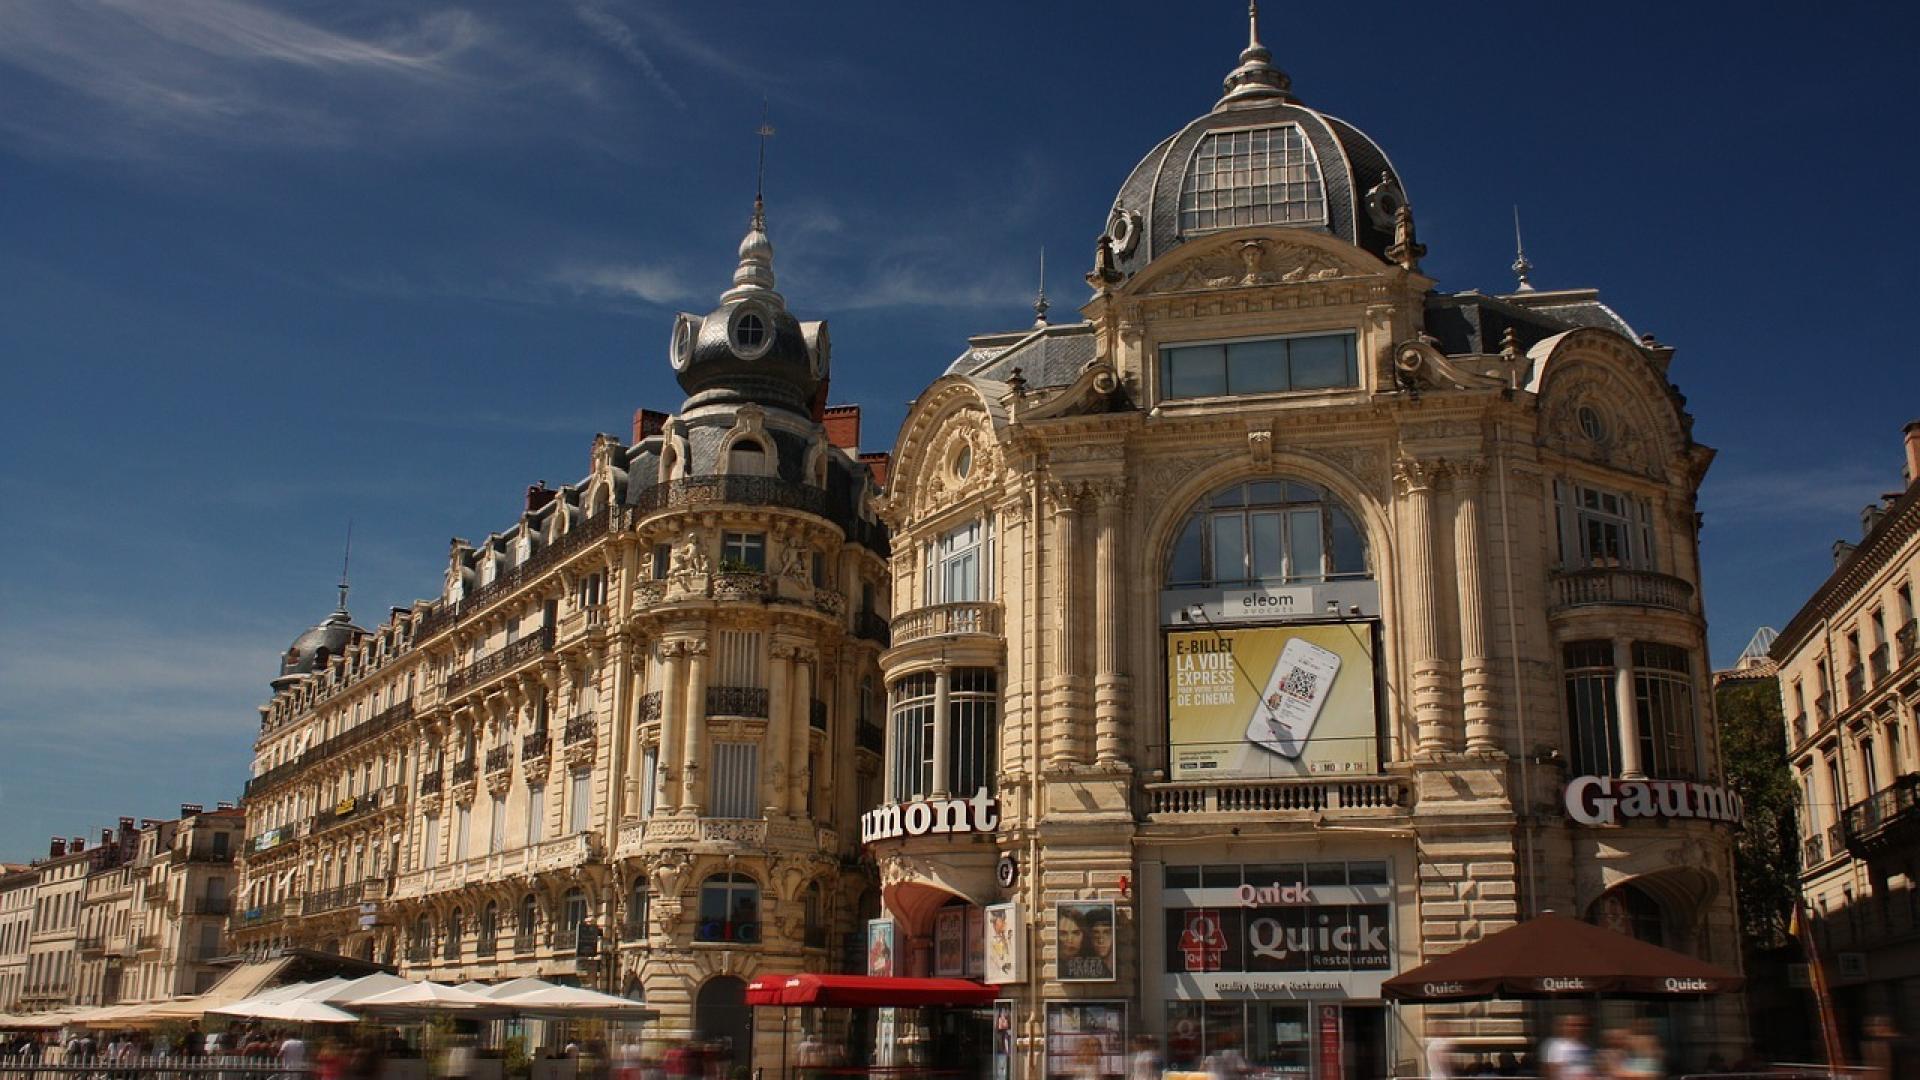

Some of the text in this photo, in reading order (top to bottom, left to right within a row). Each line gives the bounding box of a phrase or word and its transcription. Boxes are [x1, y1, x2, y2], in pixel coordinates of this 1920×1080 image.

[1177, 638, 1233, 654] E-BILLET
[1177, 653, 1234, 671] LA VOIE
[1177, 670, 1235, 687] EXPRESS
[1178, 693, 1191, 705] DE
[1237, 881, 1312, 909] Quick
[1250, 914, 1388, 960] Quick
[1313, 954, 1389, 966] Restaurant
[1424, 983, 1464, 996] Quick
[1543, 977, 1584, 992] Quick
[1665, 977, 1708, 992] Quick
